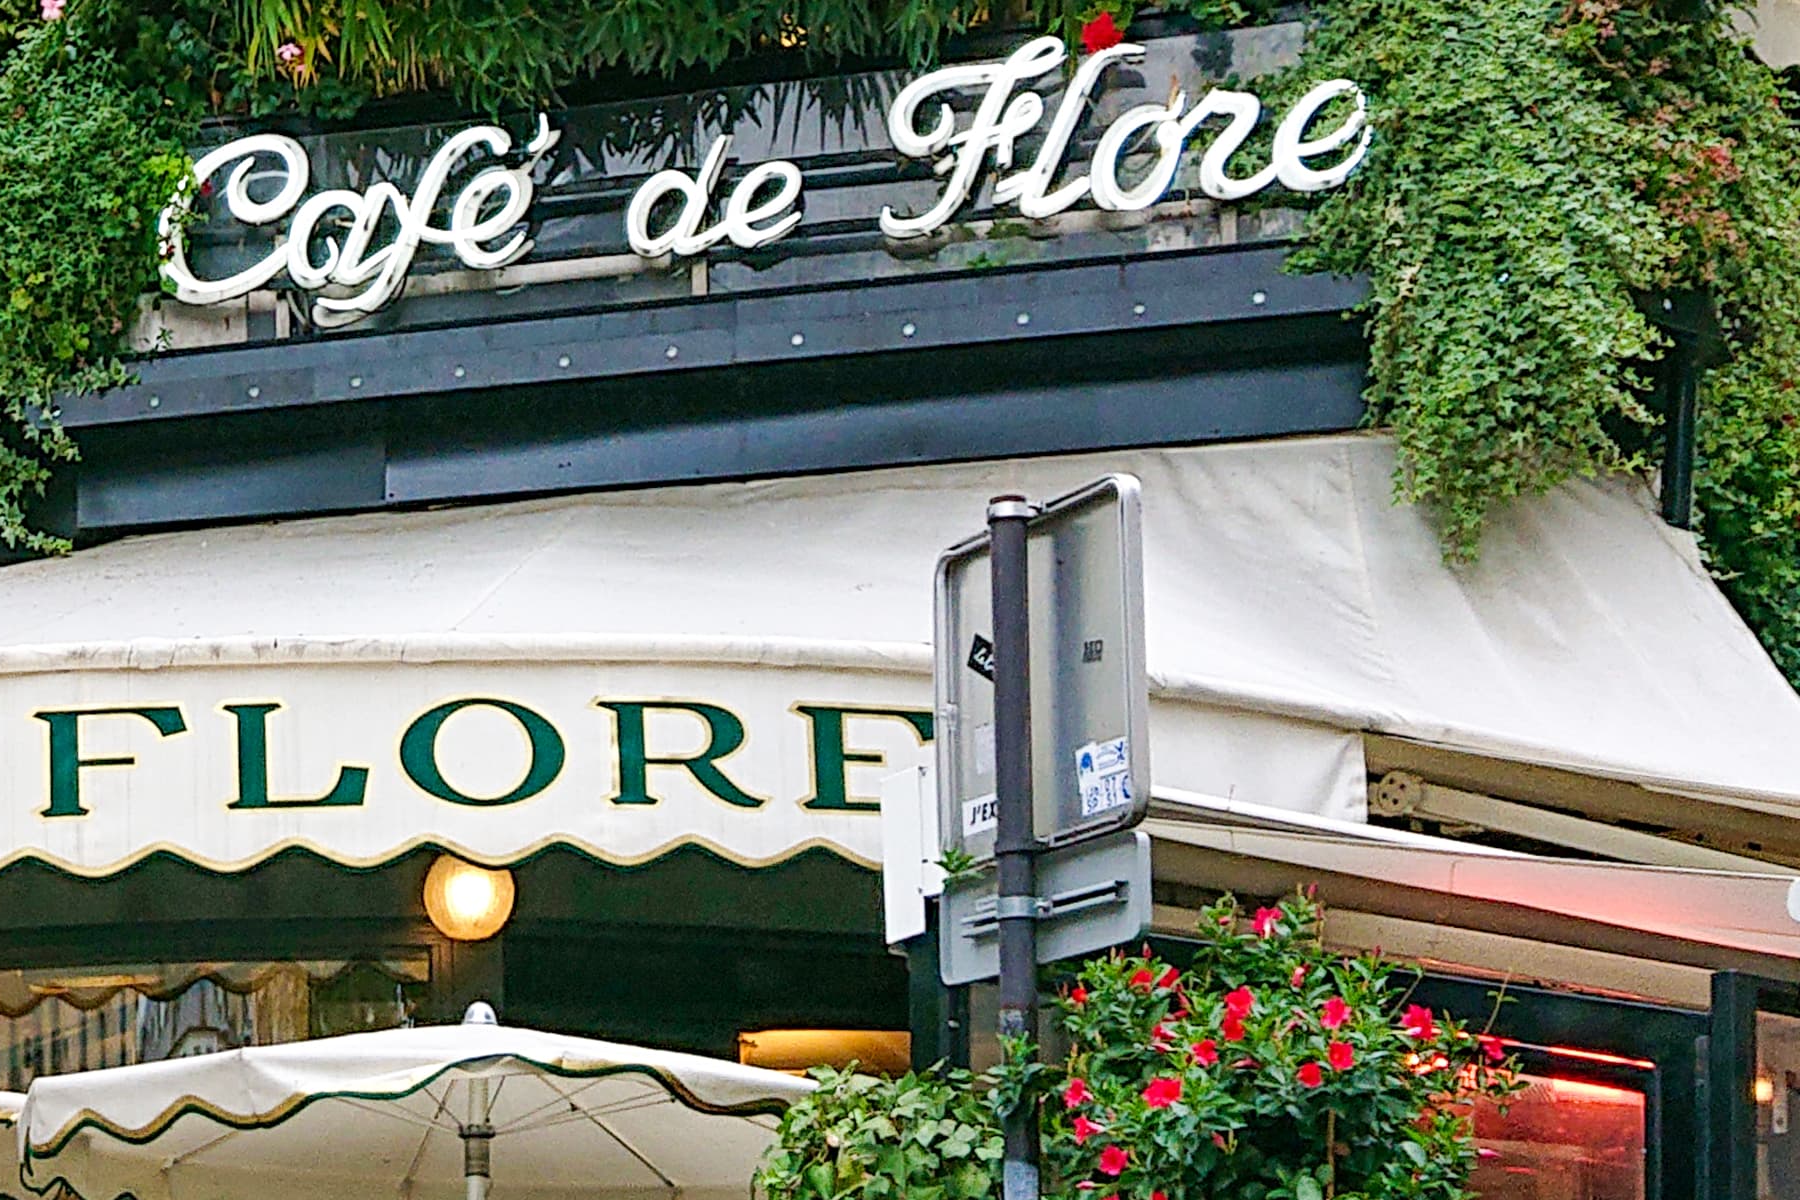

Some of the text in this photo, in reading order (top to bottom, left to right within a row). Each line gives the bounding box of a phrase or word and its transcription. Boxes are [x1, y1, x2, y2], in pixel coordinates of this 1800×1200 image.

[158, 35, 1372, 328] Café de Flore
[32, 696, 933, 817] FLORE
